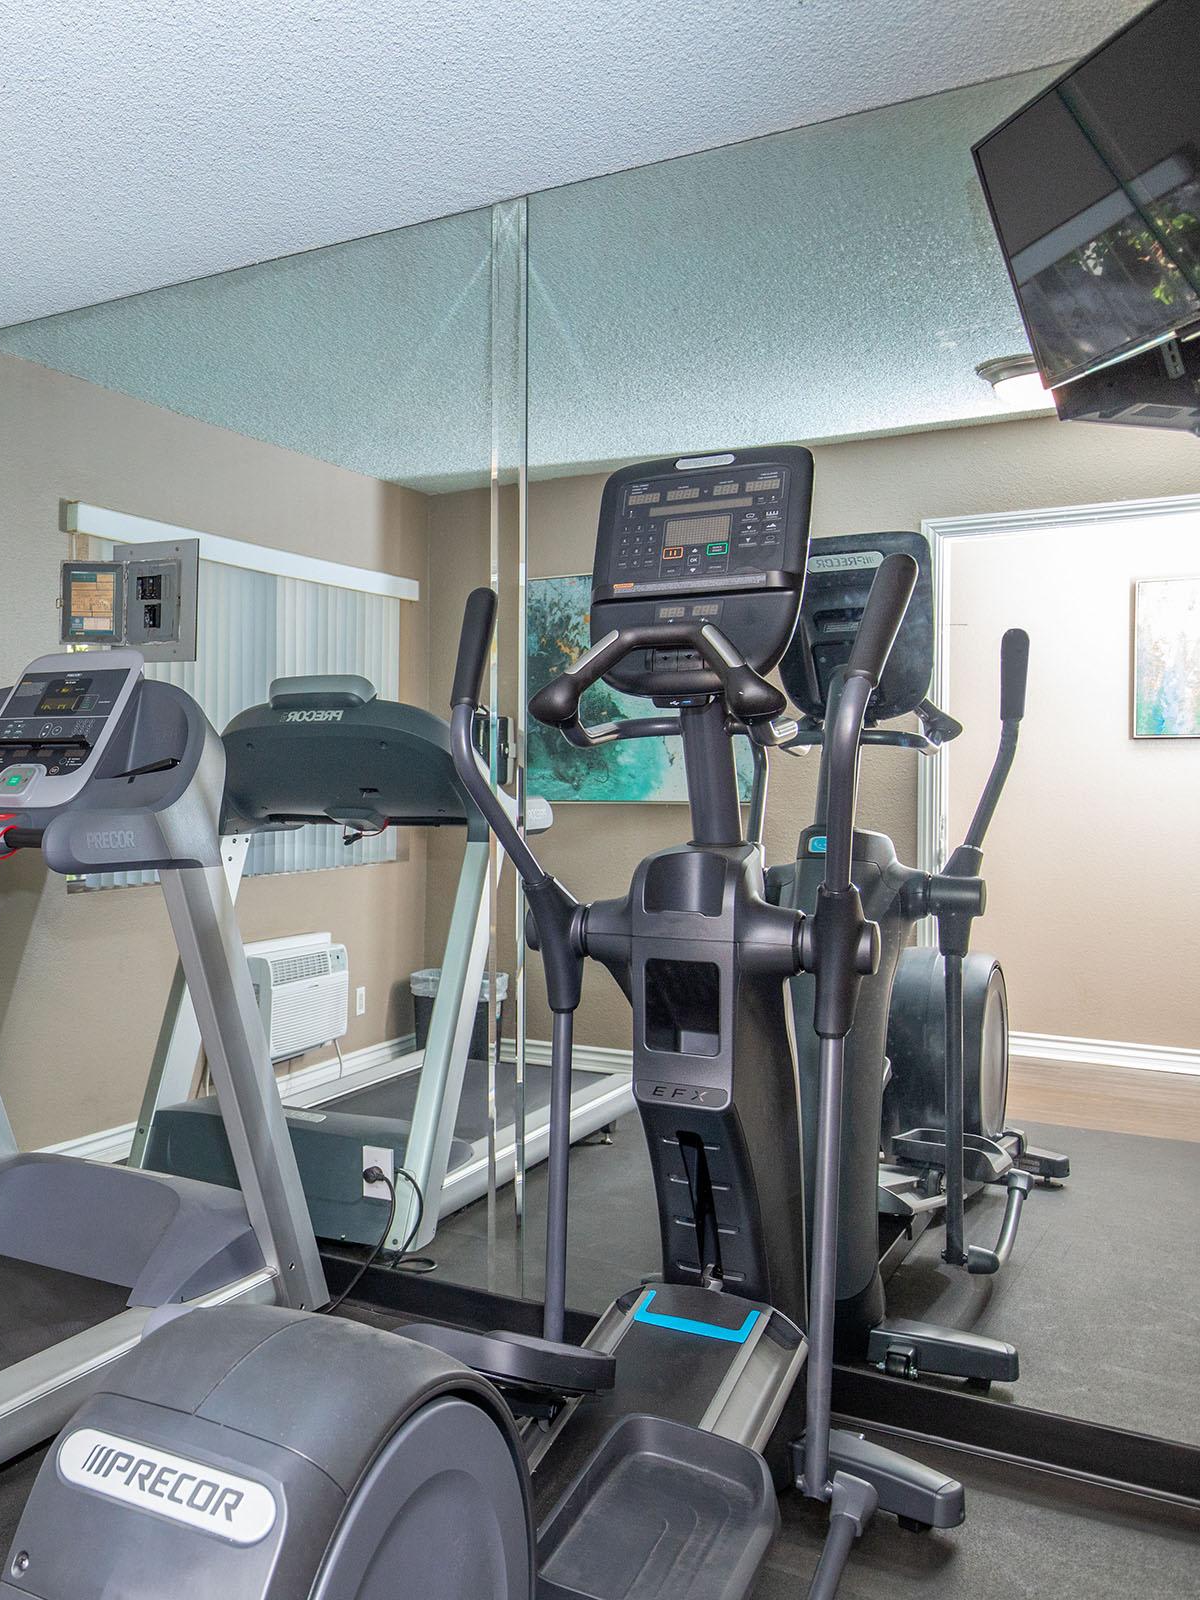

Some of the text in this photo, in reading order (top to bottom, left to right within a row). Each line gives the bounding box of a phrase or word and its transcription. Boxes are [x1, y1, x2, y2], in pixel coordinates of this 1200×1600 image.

[86, 830, 135, 849] PRECOR
[652, 1086, 707, 1102] EFX
[101, 1451, 244, 1522] PRECOR
